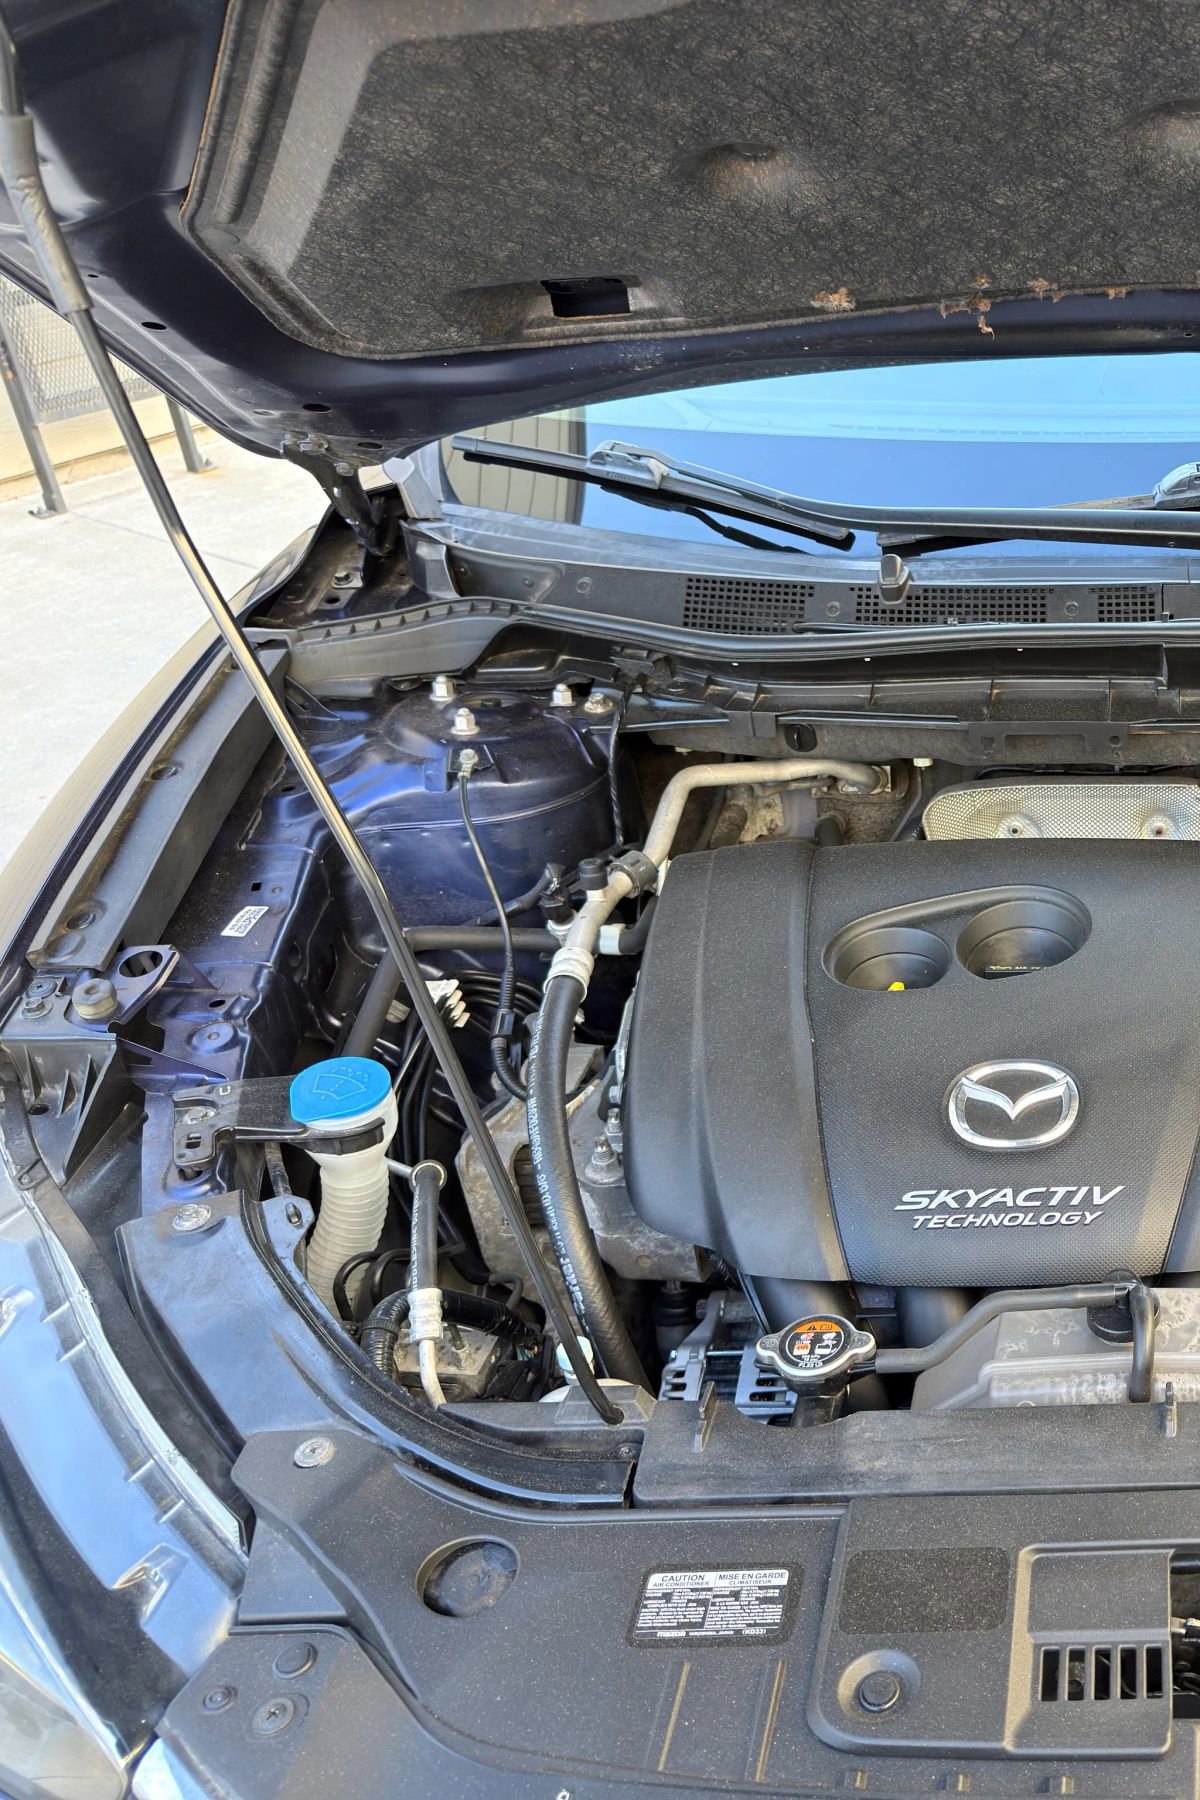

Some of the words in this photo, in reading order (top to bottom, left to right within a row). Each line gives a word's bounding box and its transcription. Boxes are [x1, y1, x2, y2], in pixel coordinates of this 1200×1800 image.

[894, 1186, 1126, 1211] SKYACTIV
[912, 1211, 1104, 1230] TECHNOLOGY
[662, 1574, 705, 1582] CAUTION
[742, 1572, 754, 1580] EN
[755, 1571, 786, 1579] GARDE
